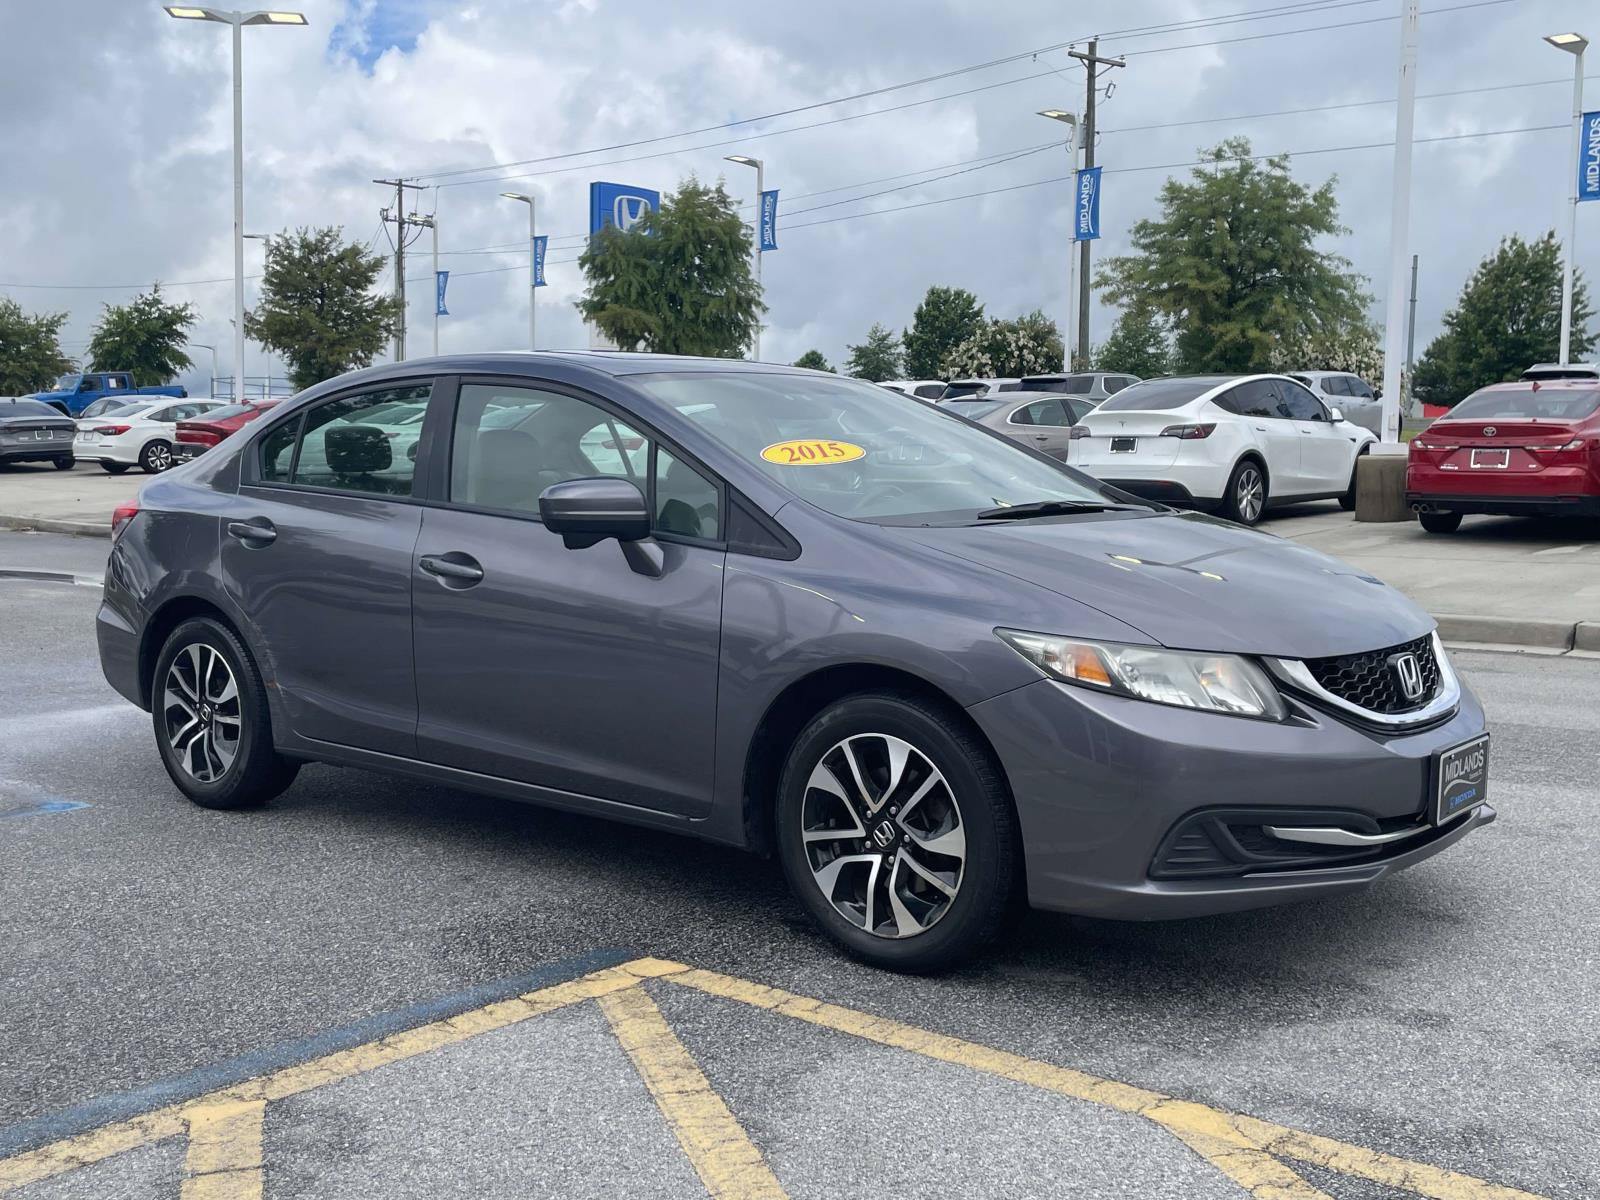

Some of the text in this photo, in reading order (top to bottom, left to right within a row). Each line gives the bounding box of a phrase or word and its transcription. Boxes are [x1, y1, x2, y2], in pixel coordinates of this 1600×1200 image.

[1586, 118, 1600, 192] MIDLANDS
[1080, 174, 1091, 233] MIDLANDS
[780, 443, 845, 462] 2015
[1445, 749, 1485, 784] MIDLANDS
